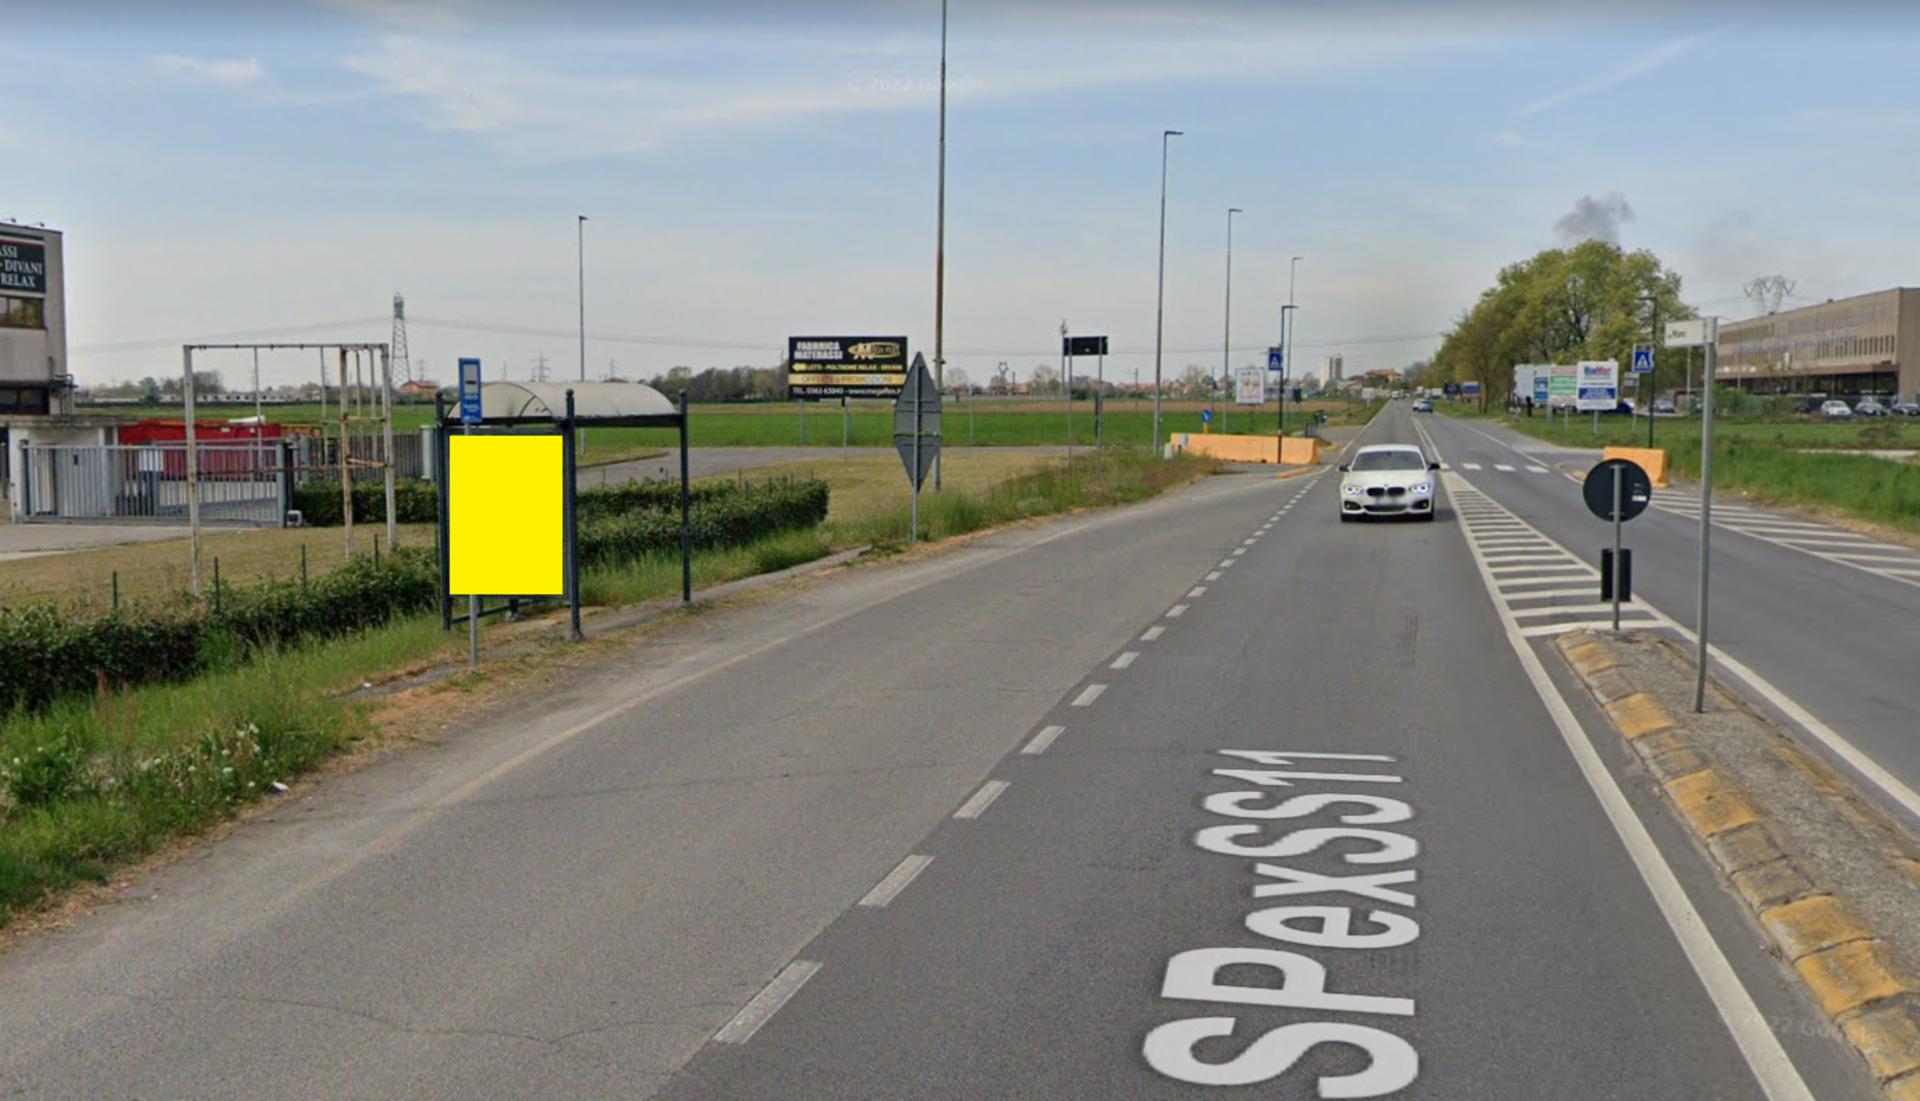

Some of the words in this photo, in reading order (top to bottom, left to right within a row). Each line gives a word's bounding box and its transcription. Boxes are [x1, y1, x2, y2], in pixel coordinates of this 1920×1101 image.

[0, 244, 17, 258] SSI
[4, 259, 43, 275] DIVANI
[0, 272, 36, 288] RELAX
[793, 350, 843, 360] MATERASSI
